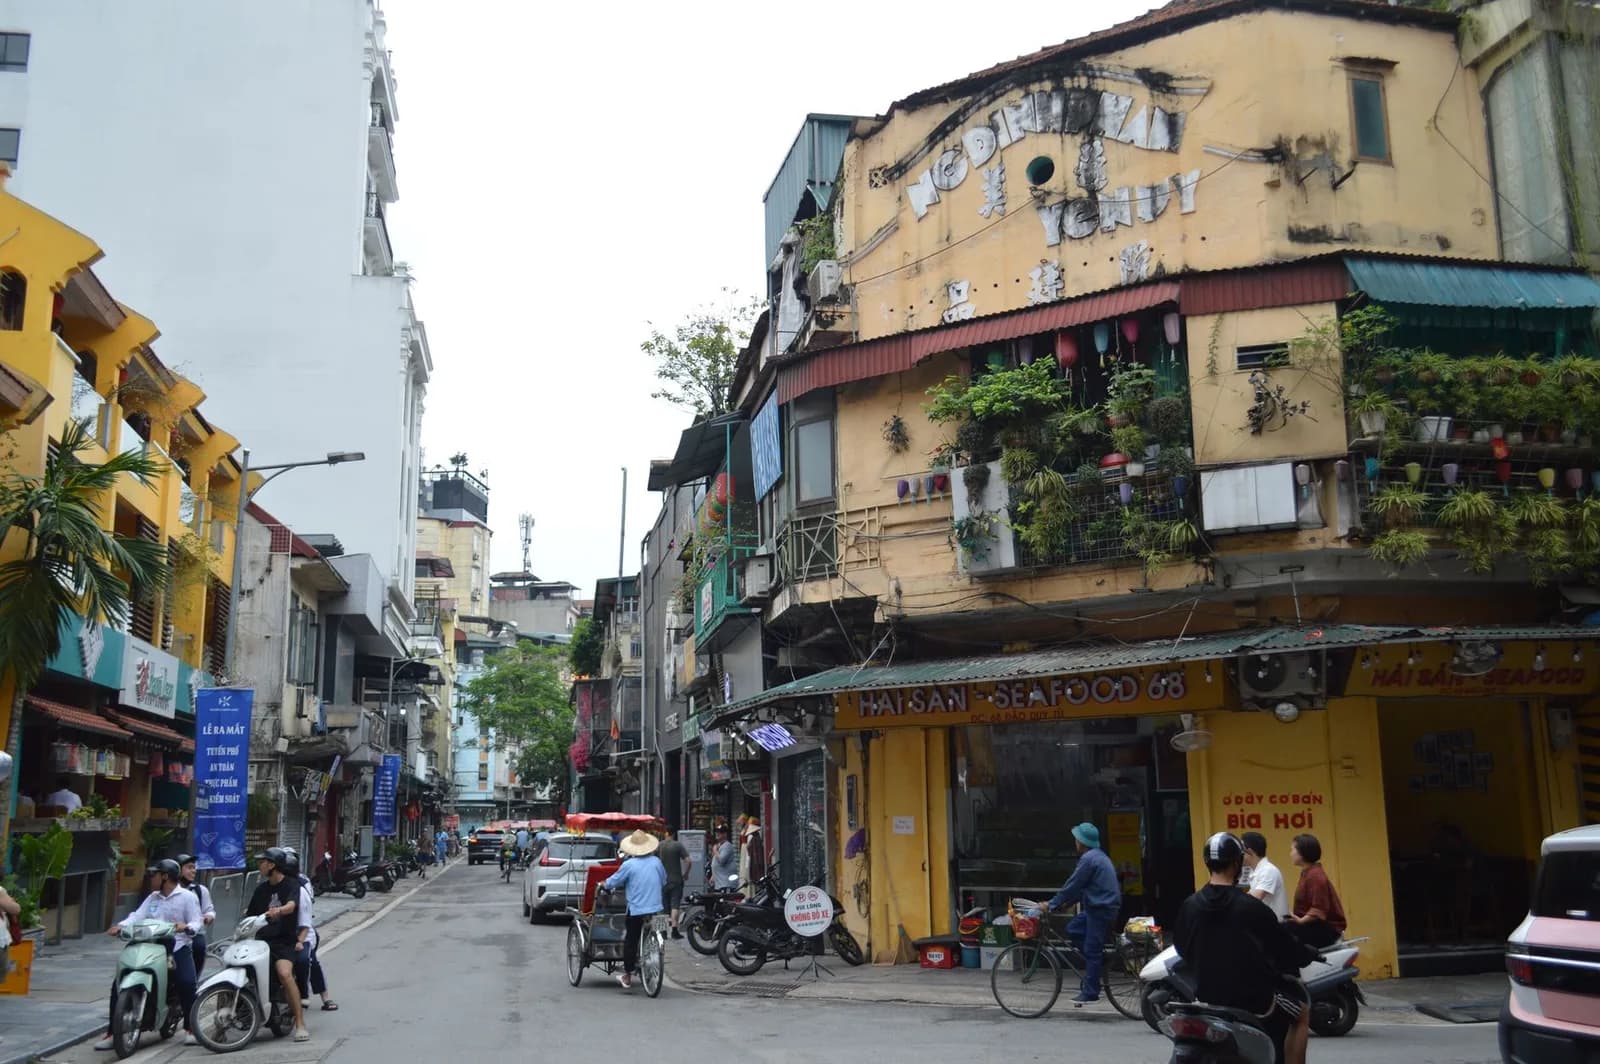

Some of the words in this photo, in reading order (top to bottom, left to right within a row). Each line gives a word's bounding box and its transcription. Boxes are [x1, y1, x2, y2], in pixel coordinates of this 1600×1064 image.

[995, 675, 1139, 708] SEAFOOD
[1147, 671, 1187, 700] 68
[213, 725, 225, 735] RA
